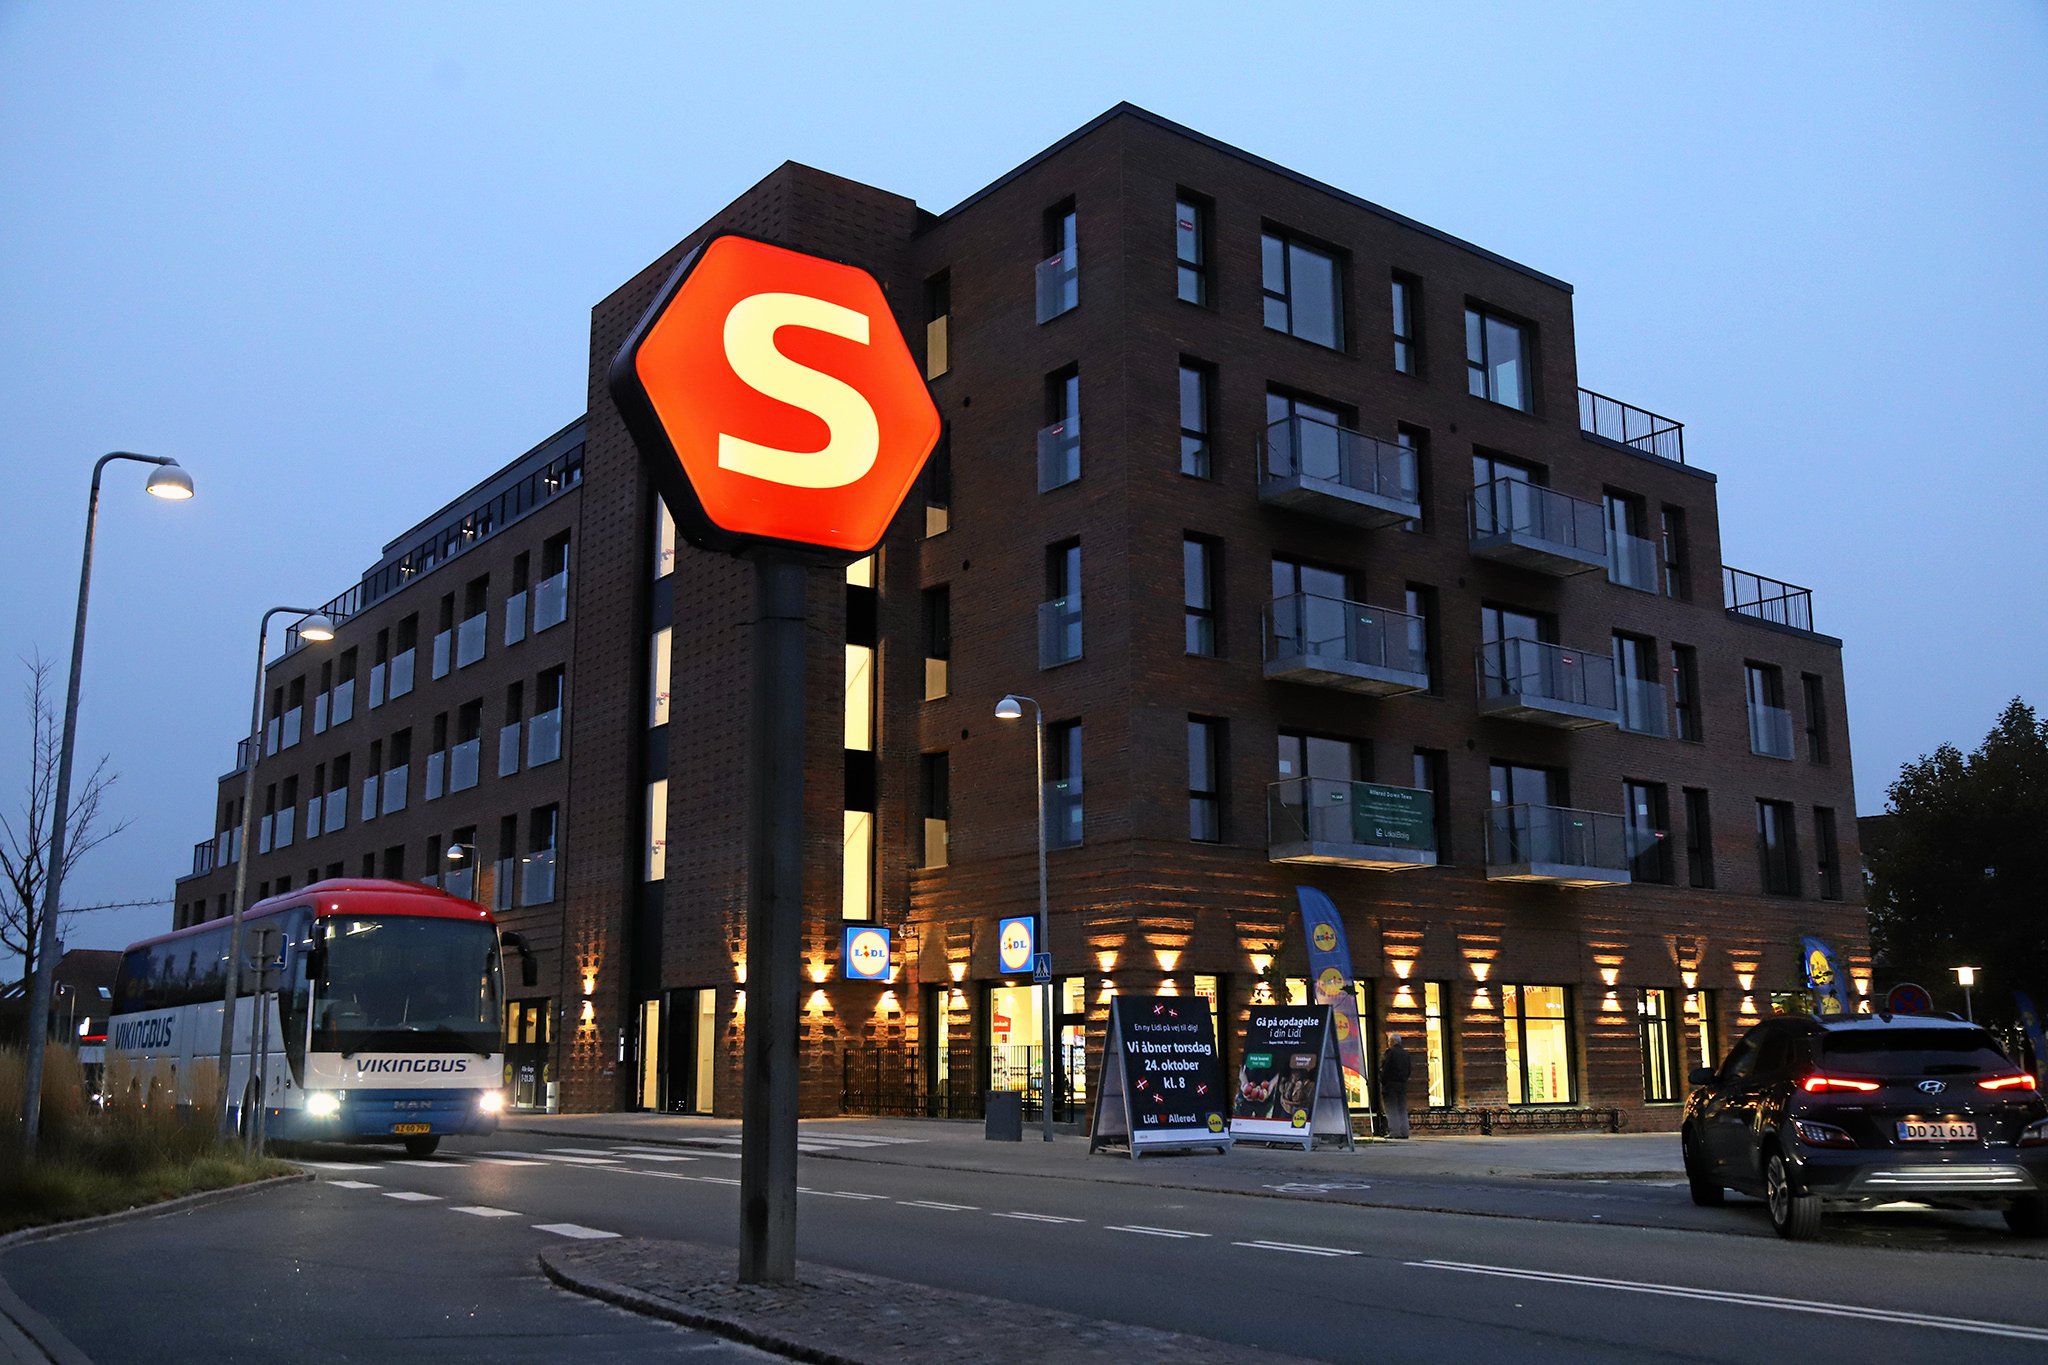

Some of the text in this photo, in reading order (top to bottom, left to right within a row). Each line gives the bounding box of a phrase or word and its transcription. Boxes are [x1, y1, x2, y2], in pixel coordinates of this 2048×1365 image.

[718, 292, 880, 489] S
[1387, 791, 1400, 799] Down
[1134, 1023, 1142, 1031] En
[1143, 1024, 1151, 1032] ny
[1151, 1023, 1162, 1031] Lidl
[1163, 1024, 1171, 1032] på
[1171, 1024, 1180, 1032] vej
[1256, 1017, 1319, 1029] Gå på opdagelse
[115, 1017, 173, 1050] VIKINGBUS
[1274, 1029, 1286, 1038] din
[1287, 1029, 1302, 1038] Lidl
[1127, 1041, 1212, 1056] Vi åbner torsdag
[356, 1059, 467, 1073] VIKINGBUS
[1144, 1059, 1199, 1071] 24. oktober
[1163, 1077, 1186, 1089] kl. 8
[394, 1101, 432, 1109] MAN
[1143, 1113, 1197, 1124] Lidl Allerød
[1908, 1125, 1975, 1138] DD 21 612
